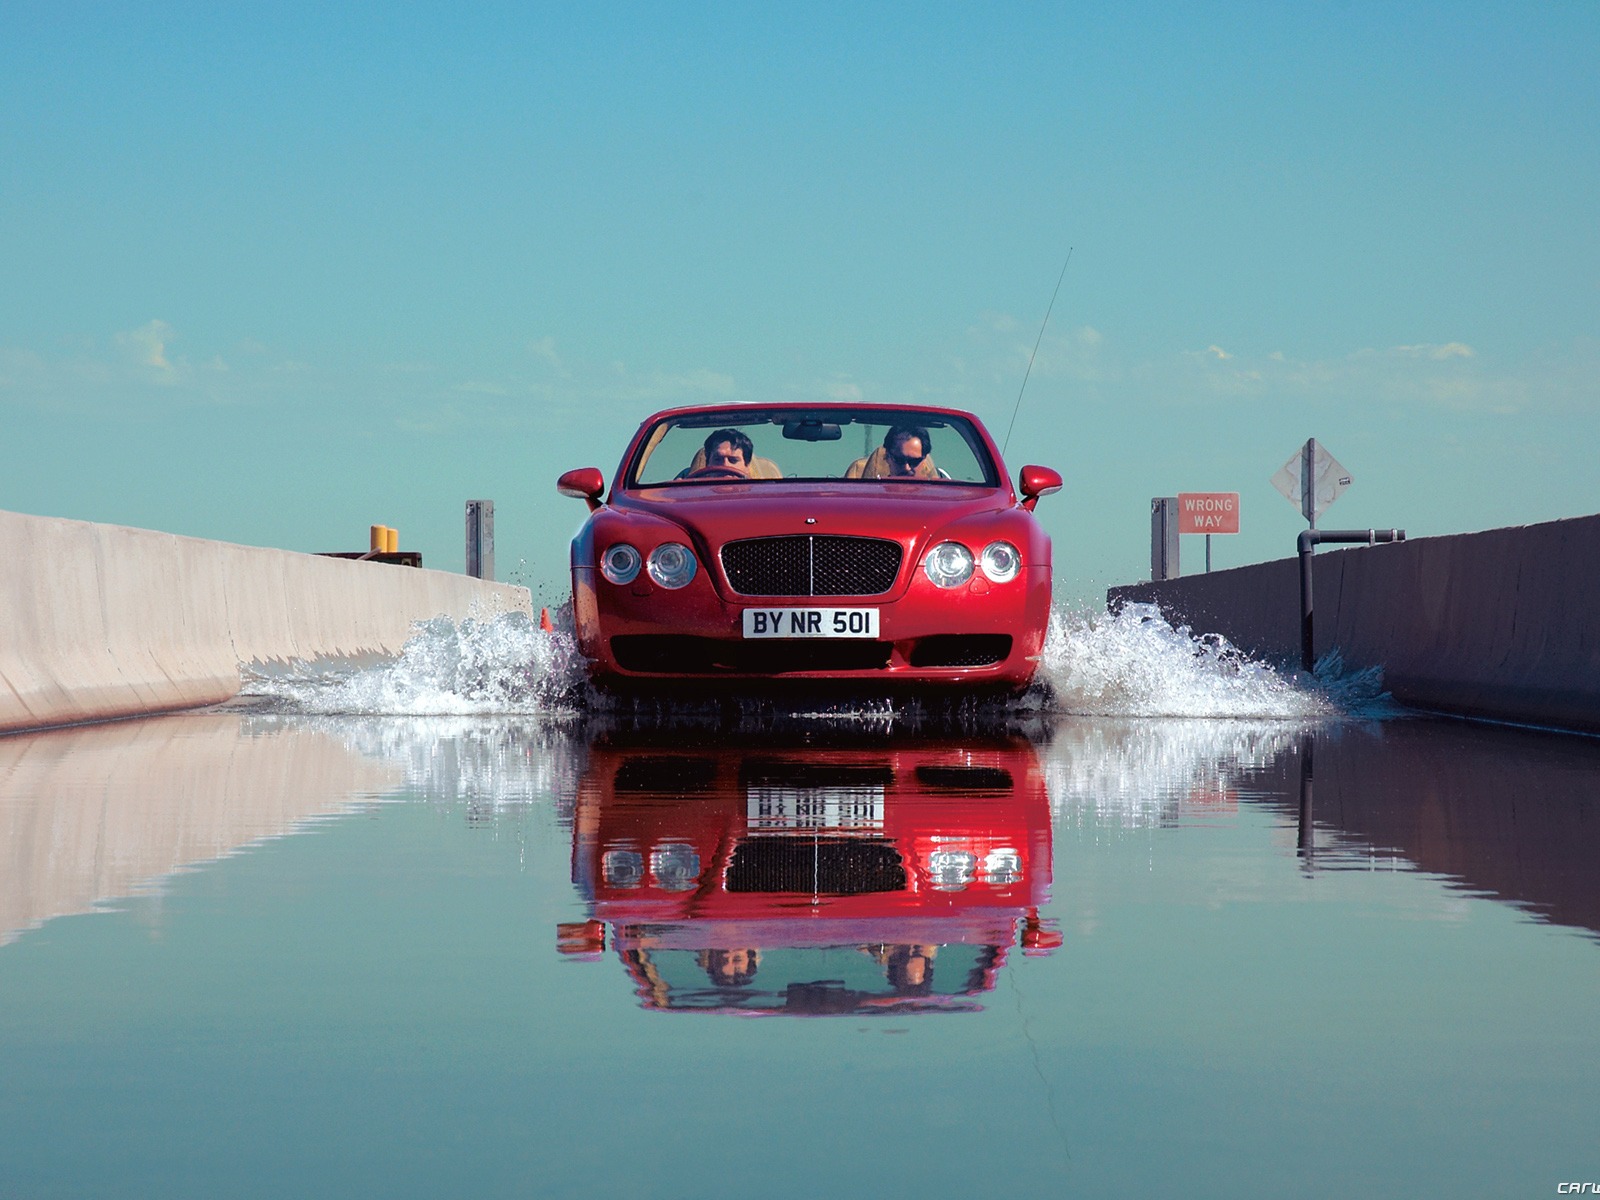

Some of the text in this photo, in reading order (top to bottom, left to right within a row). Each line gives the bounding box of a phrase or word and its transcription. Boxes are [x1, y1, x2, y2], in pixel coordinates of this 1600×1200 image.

[1185, 499, 1232, 511] WRONG
[1194, 515, 1222, 527] WAY
[753, 611, 869, 633] BY NR 501
